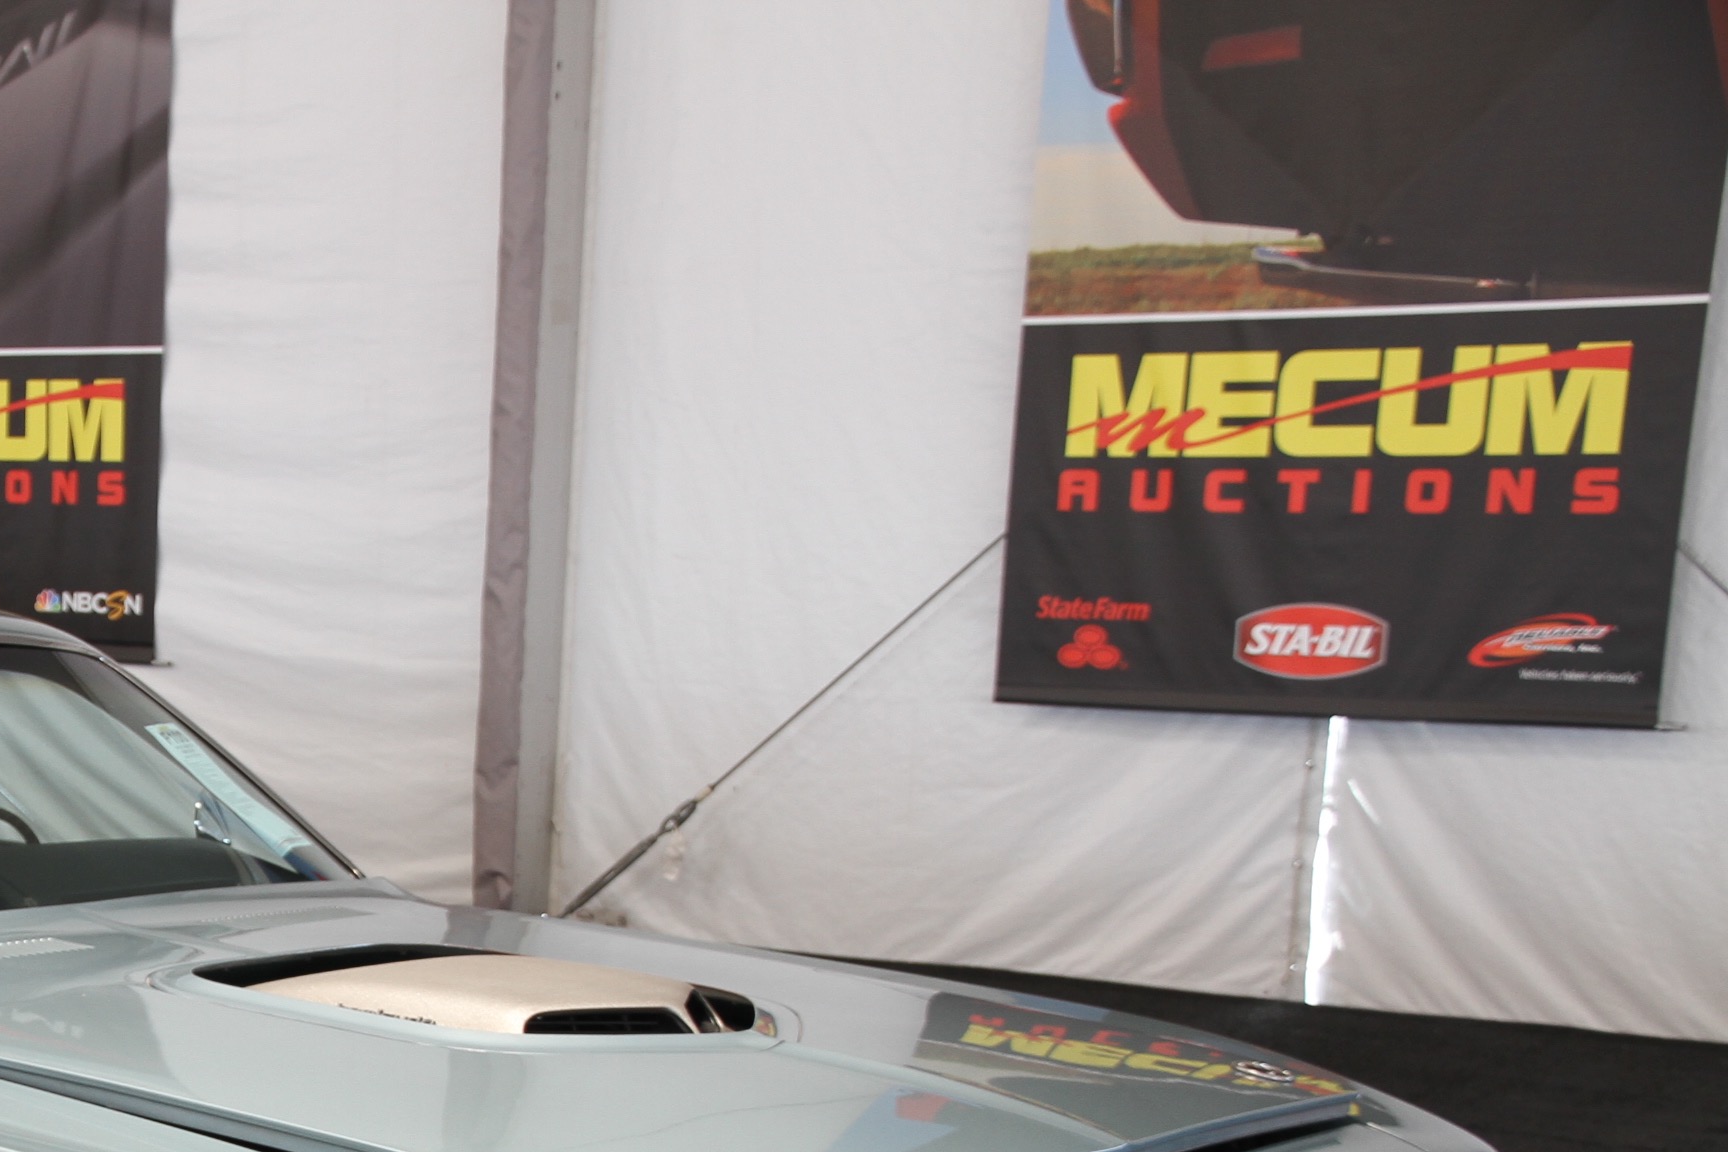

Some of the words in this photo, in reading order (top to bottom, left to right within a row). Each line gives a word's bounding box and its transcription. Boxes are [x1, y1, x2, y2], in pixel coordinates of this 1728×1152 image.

[1064, 341, 1633, 457] MECUM
[1056, 467, 1621, 514] AUCTIONS
[1244, 622, 1375, 659] STA-BIL
